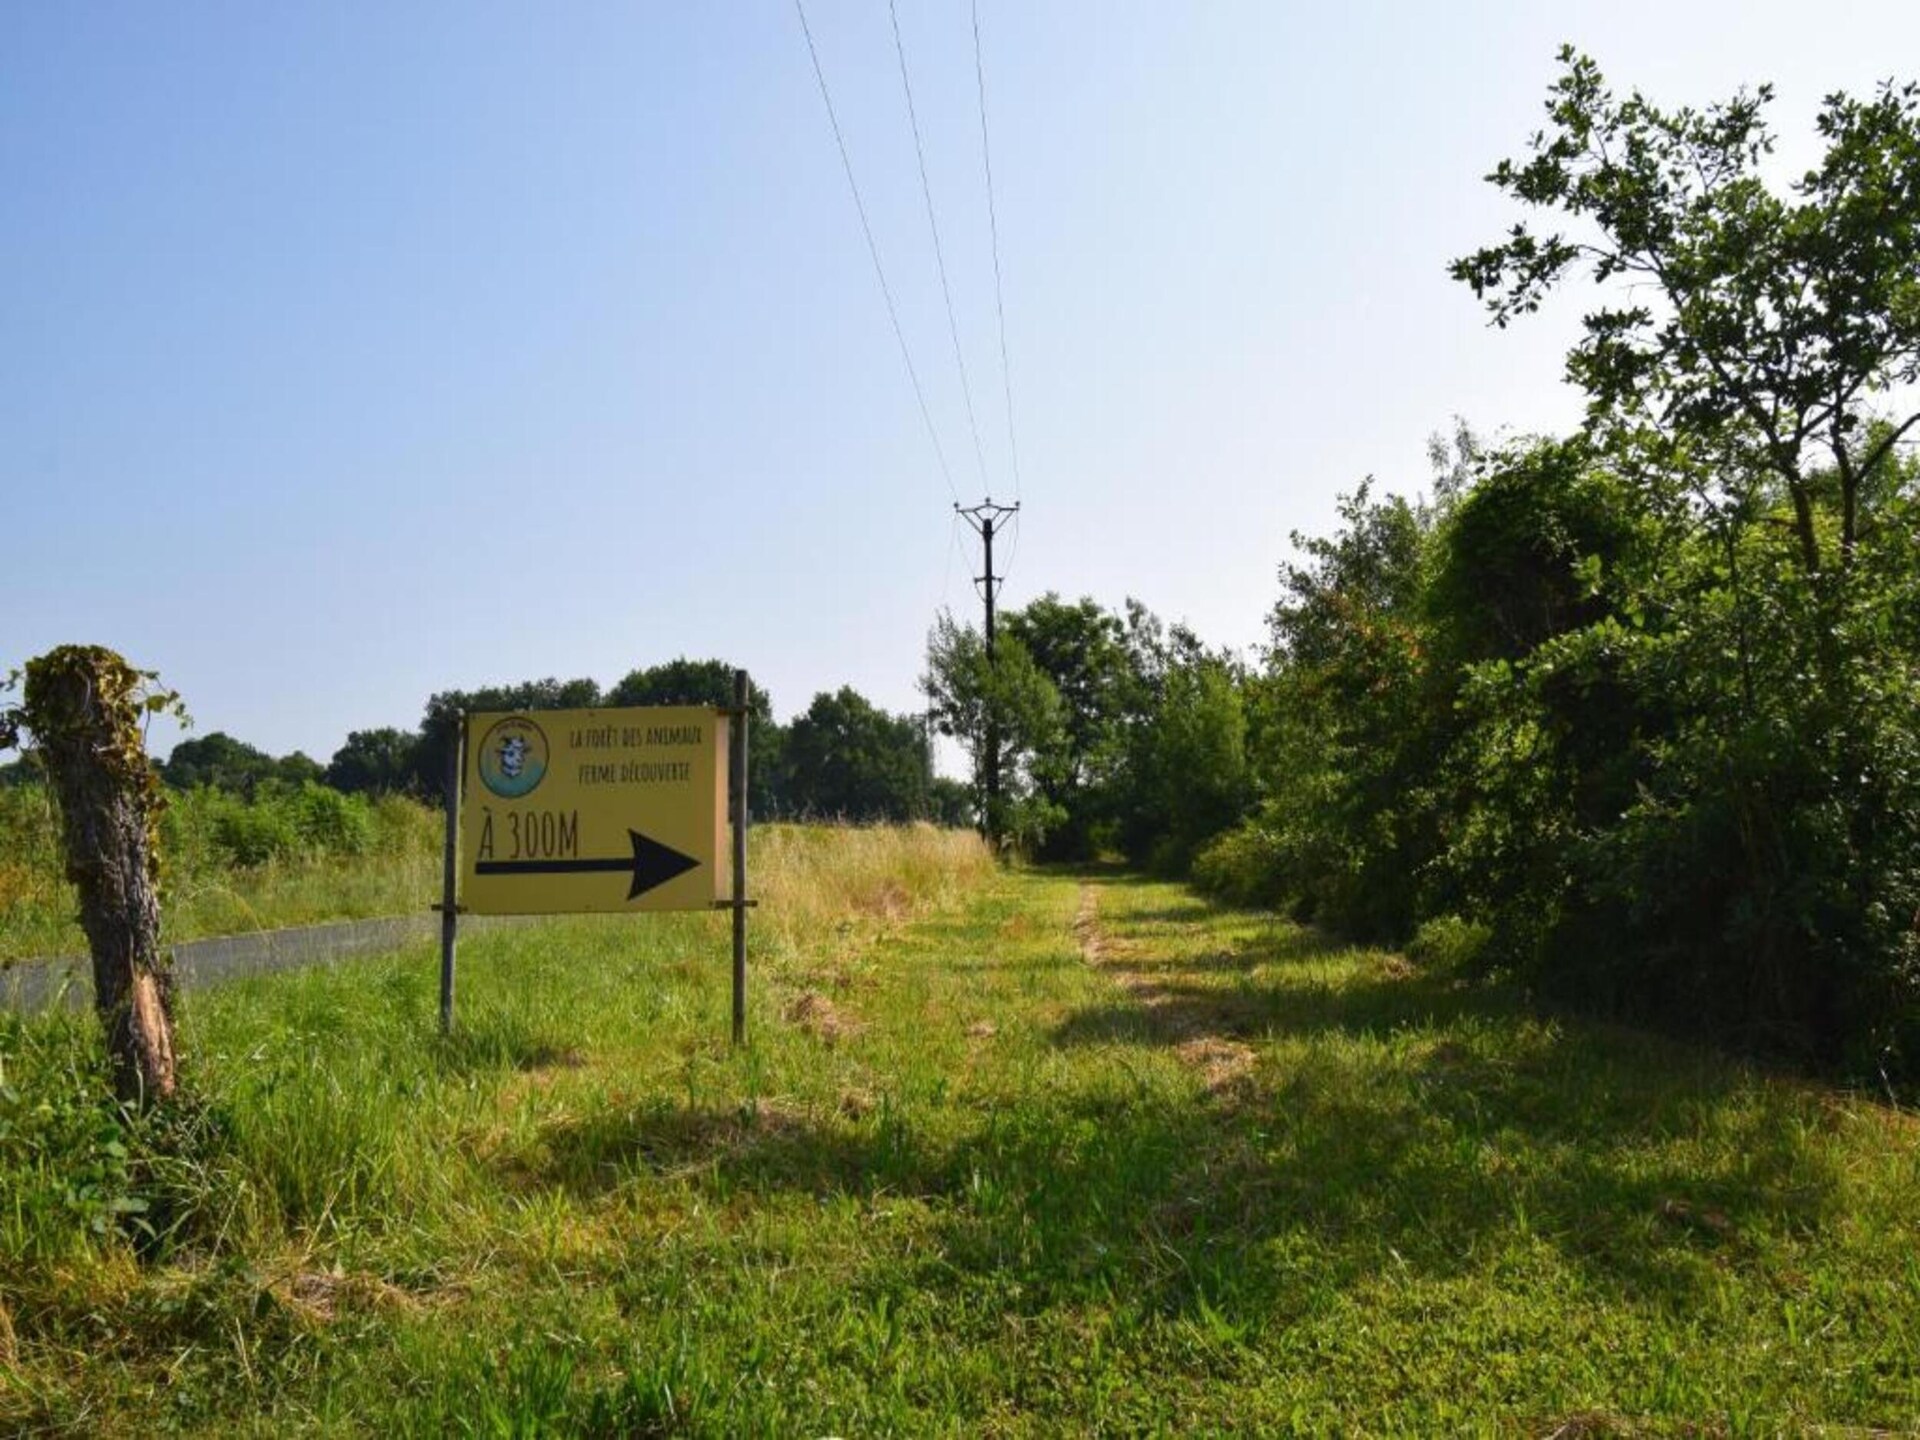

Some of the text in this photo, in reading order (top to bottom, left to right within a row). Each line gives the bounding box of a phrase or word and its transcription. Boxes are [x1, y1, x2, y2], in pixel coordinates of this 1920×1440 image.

[570, 725, 702, 748] LA FORÊT DES ANIMAUX
[578, 760, 690, 784] FERME DÉCOUVERTE
[479, 806, 578, 858] À 300M
